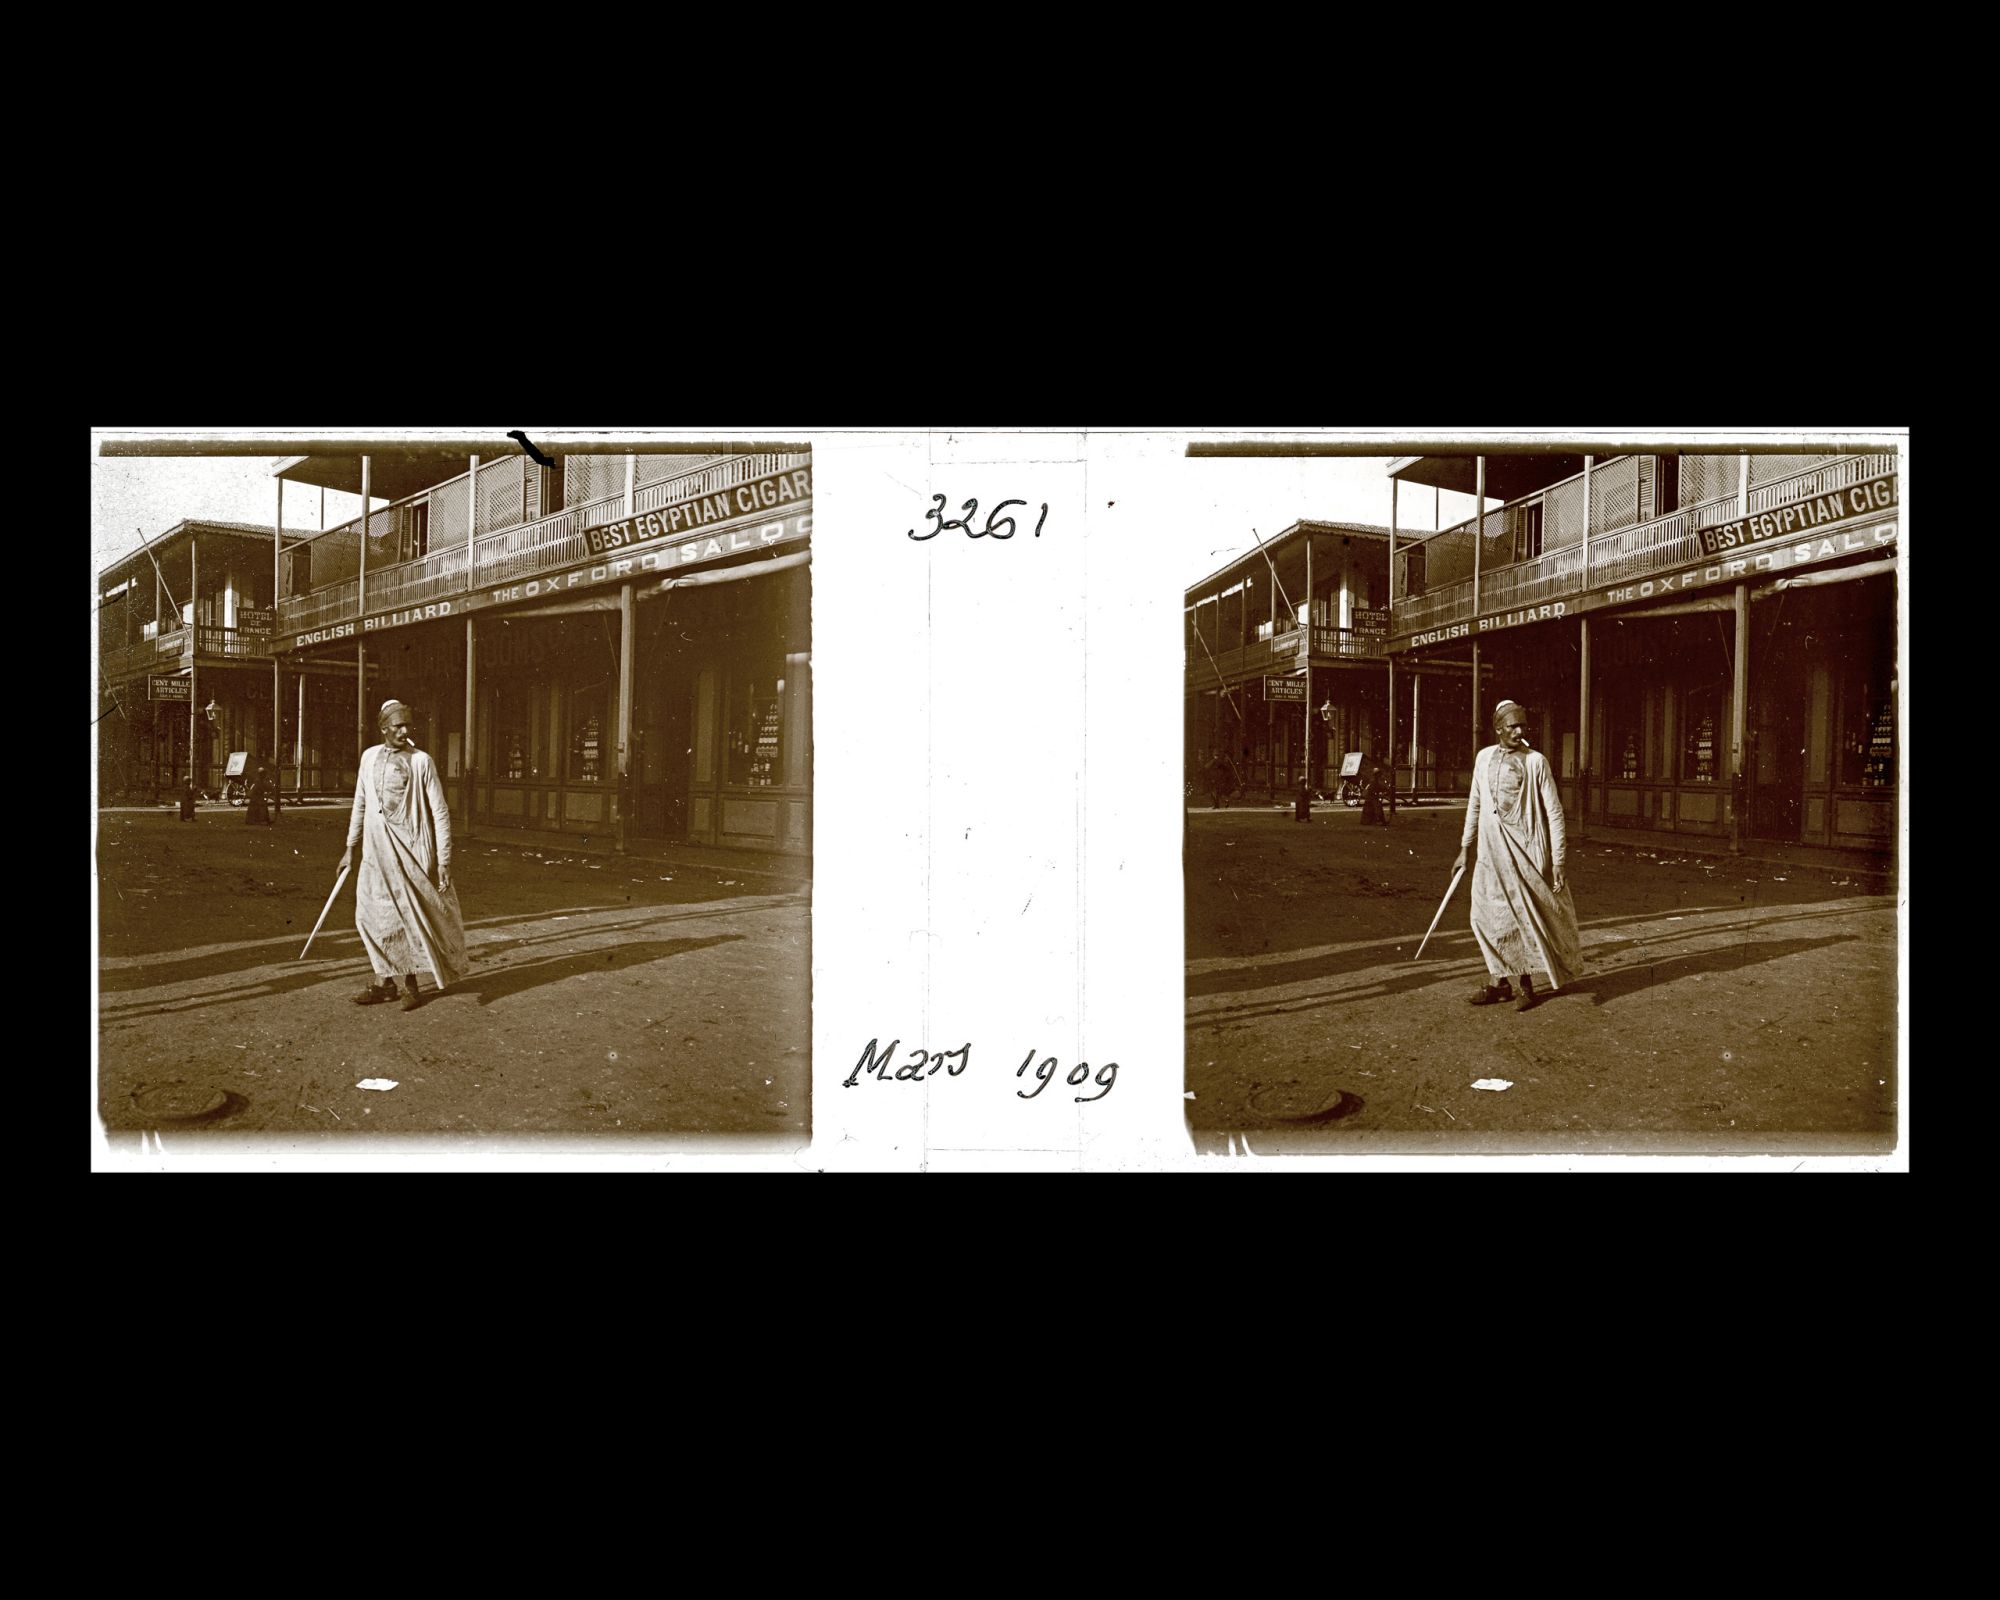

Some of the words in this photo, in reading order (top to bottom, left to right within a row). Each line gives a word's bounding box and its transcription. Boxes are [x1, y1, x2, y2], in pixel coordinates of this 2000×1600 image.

[590, 520, 630, 552] BEST
[634, 492, 731, 541] EGYPTIAN
[735, 469, 812, 512] CIGAR
[907, 493, 1048, 541] 3261
[1704, 520, 1744, 552] BEST
[1748, 492, 1845, 541] EGYPTIAN
[492, 587, 520, 603] THE
[525, 552, 660, 597] OXFORD
[1607, 587, 1635, 603] THE
[1640, 552, 1774, 597] OXFORD
[239, 611, 273, 622] HOTEL
[296, 622, 355, 647] ENGLISH
[364, 601, 452, 632] BILLIARD
[1354, 611, 1388, 622] HOTEL
[1411, 622, 1470, 648] ENGLISH
[1478, 601, 1566, 632] BILLIARD
[155, 686, 188, 695] ARTICLES
[1266, 679, 1284, 687] CENT
[1285, 680, 1306, 688] MILLE
[1271, 686, 1304, 695] ARTICLES
[1016, 1048, 1120, 1104] 1909
